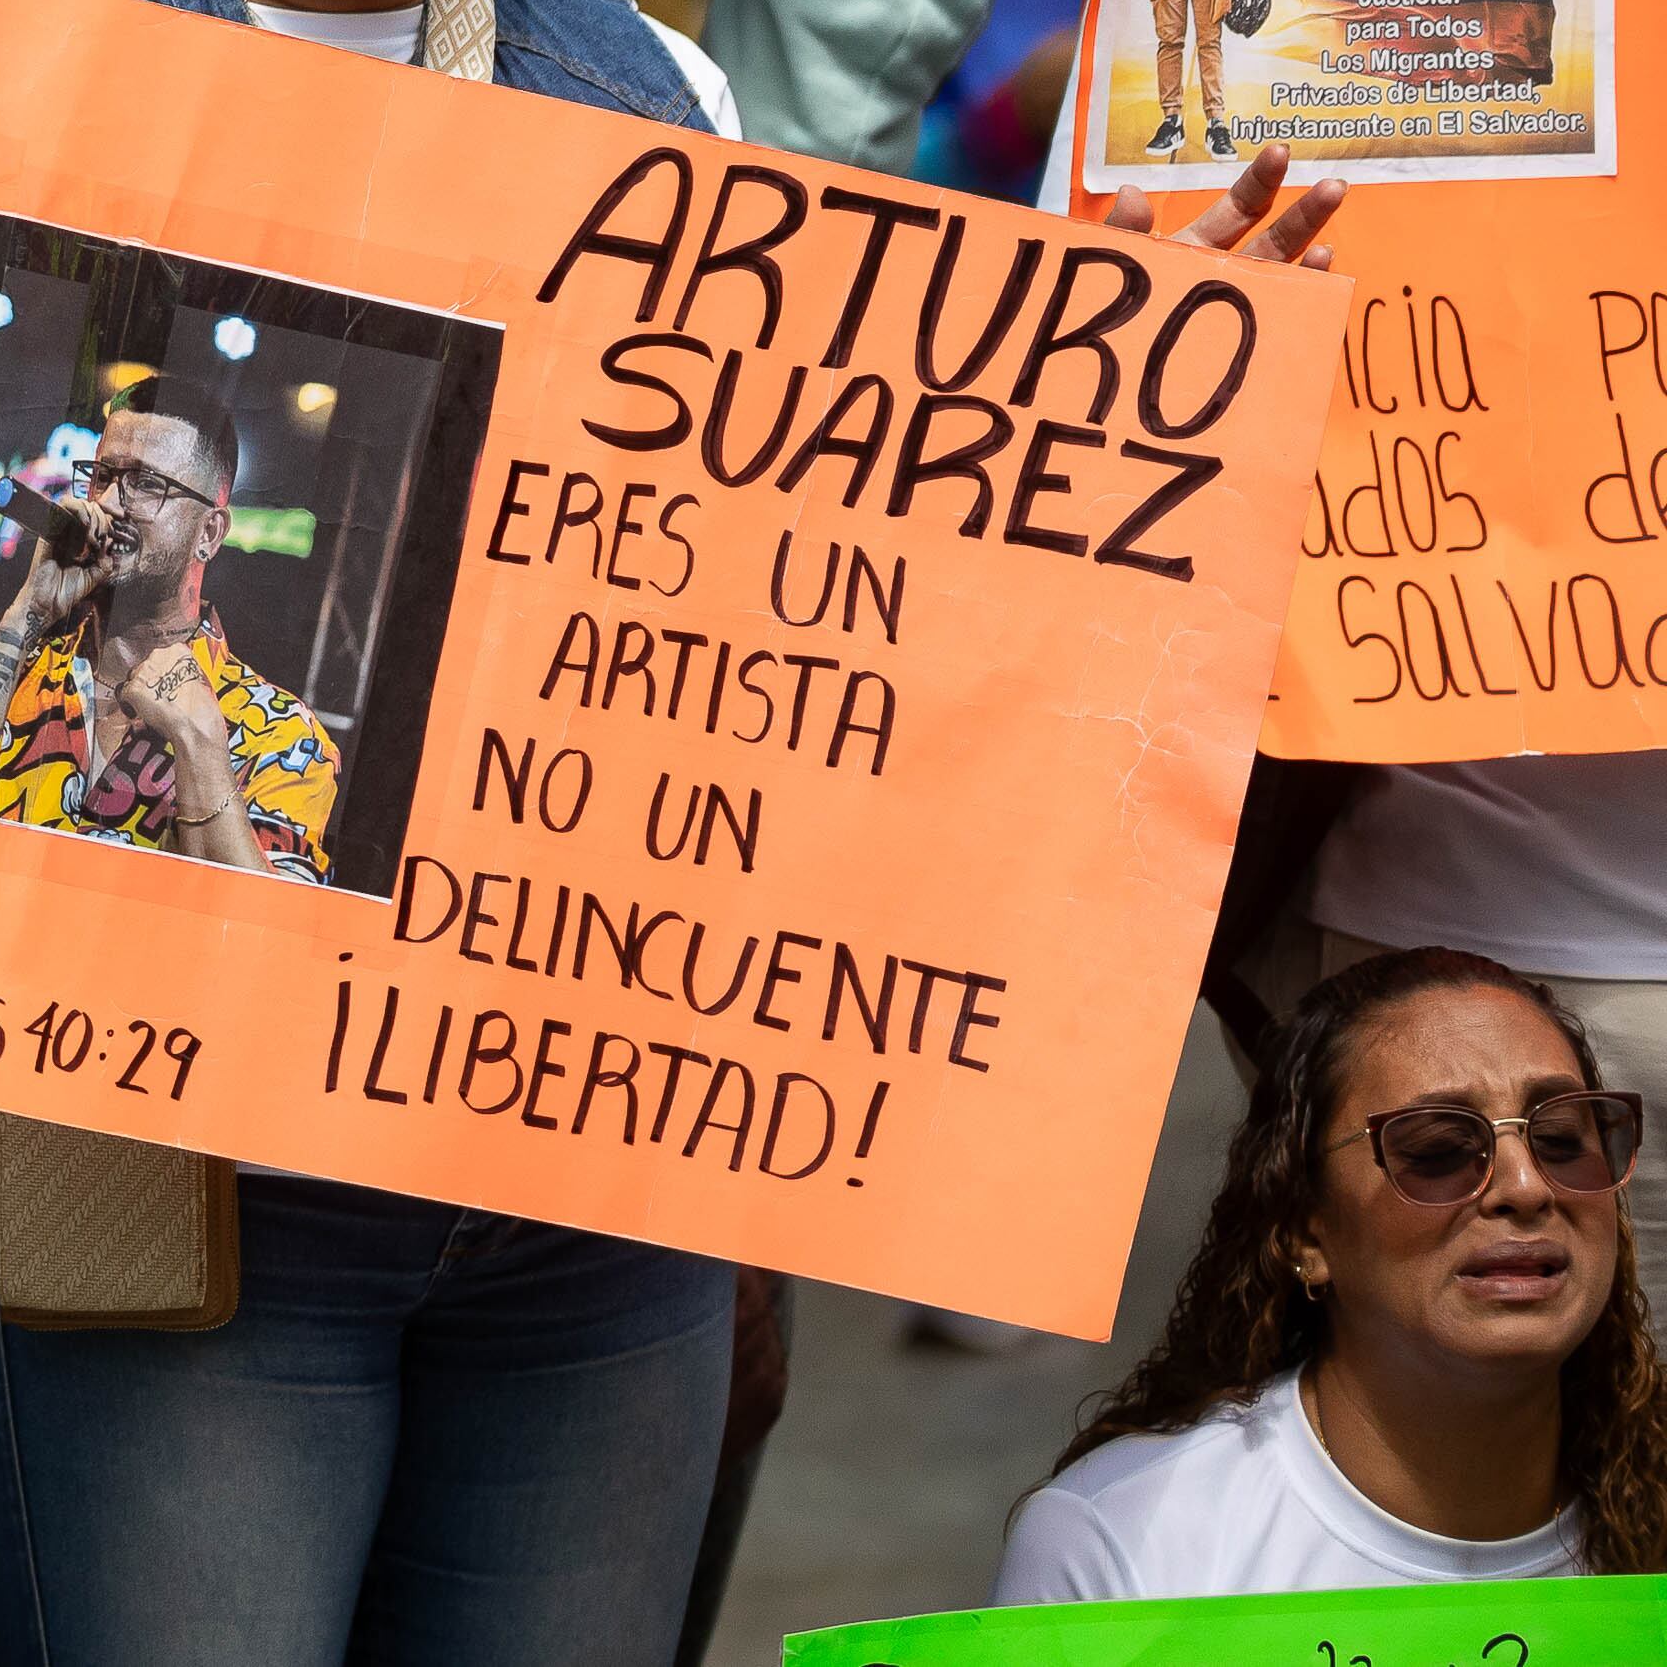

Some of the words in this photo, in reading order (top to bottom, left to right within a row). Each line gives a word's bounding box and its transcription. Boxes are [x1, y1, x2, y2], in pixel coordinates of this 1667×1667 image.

[1270, 81, 1382, 107] Privados
[1387, 80, 1419, 105] de
[1423, 78, 1541, 105] Libertad,
[1320, 48, 1365, 75] Los
[1368, 47, 1495, 77] Migrantes
[1345, 19, 1400, 44] para
[1407, 15, 1483, 40] Todos
[1230, 114, 1395, 143] Injustamente
[1401, 116, 1432, 136] en
[1437, 110, 1464, 134] El
[1468, 107, 1587, 136] Salvador.
[536, 146, 1257, 440] ARTURO
[581, 333, 1223, 583] SUAREZ
[485, 460, 703, 599] ERES
[769, 529, 907, 645] UN
[539, 611, 896, 776] ARTISTA
[471, 727, 593, 834] NO
[645, 772, 763, 873] UN
[393, 855, 1008, 1074] DELINCUENTE
[24, 999, 203, 1103] 40:29
[323, 950, 891, 1188] ¡LIBERTAD!
